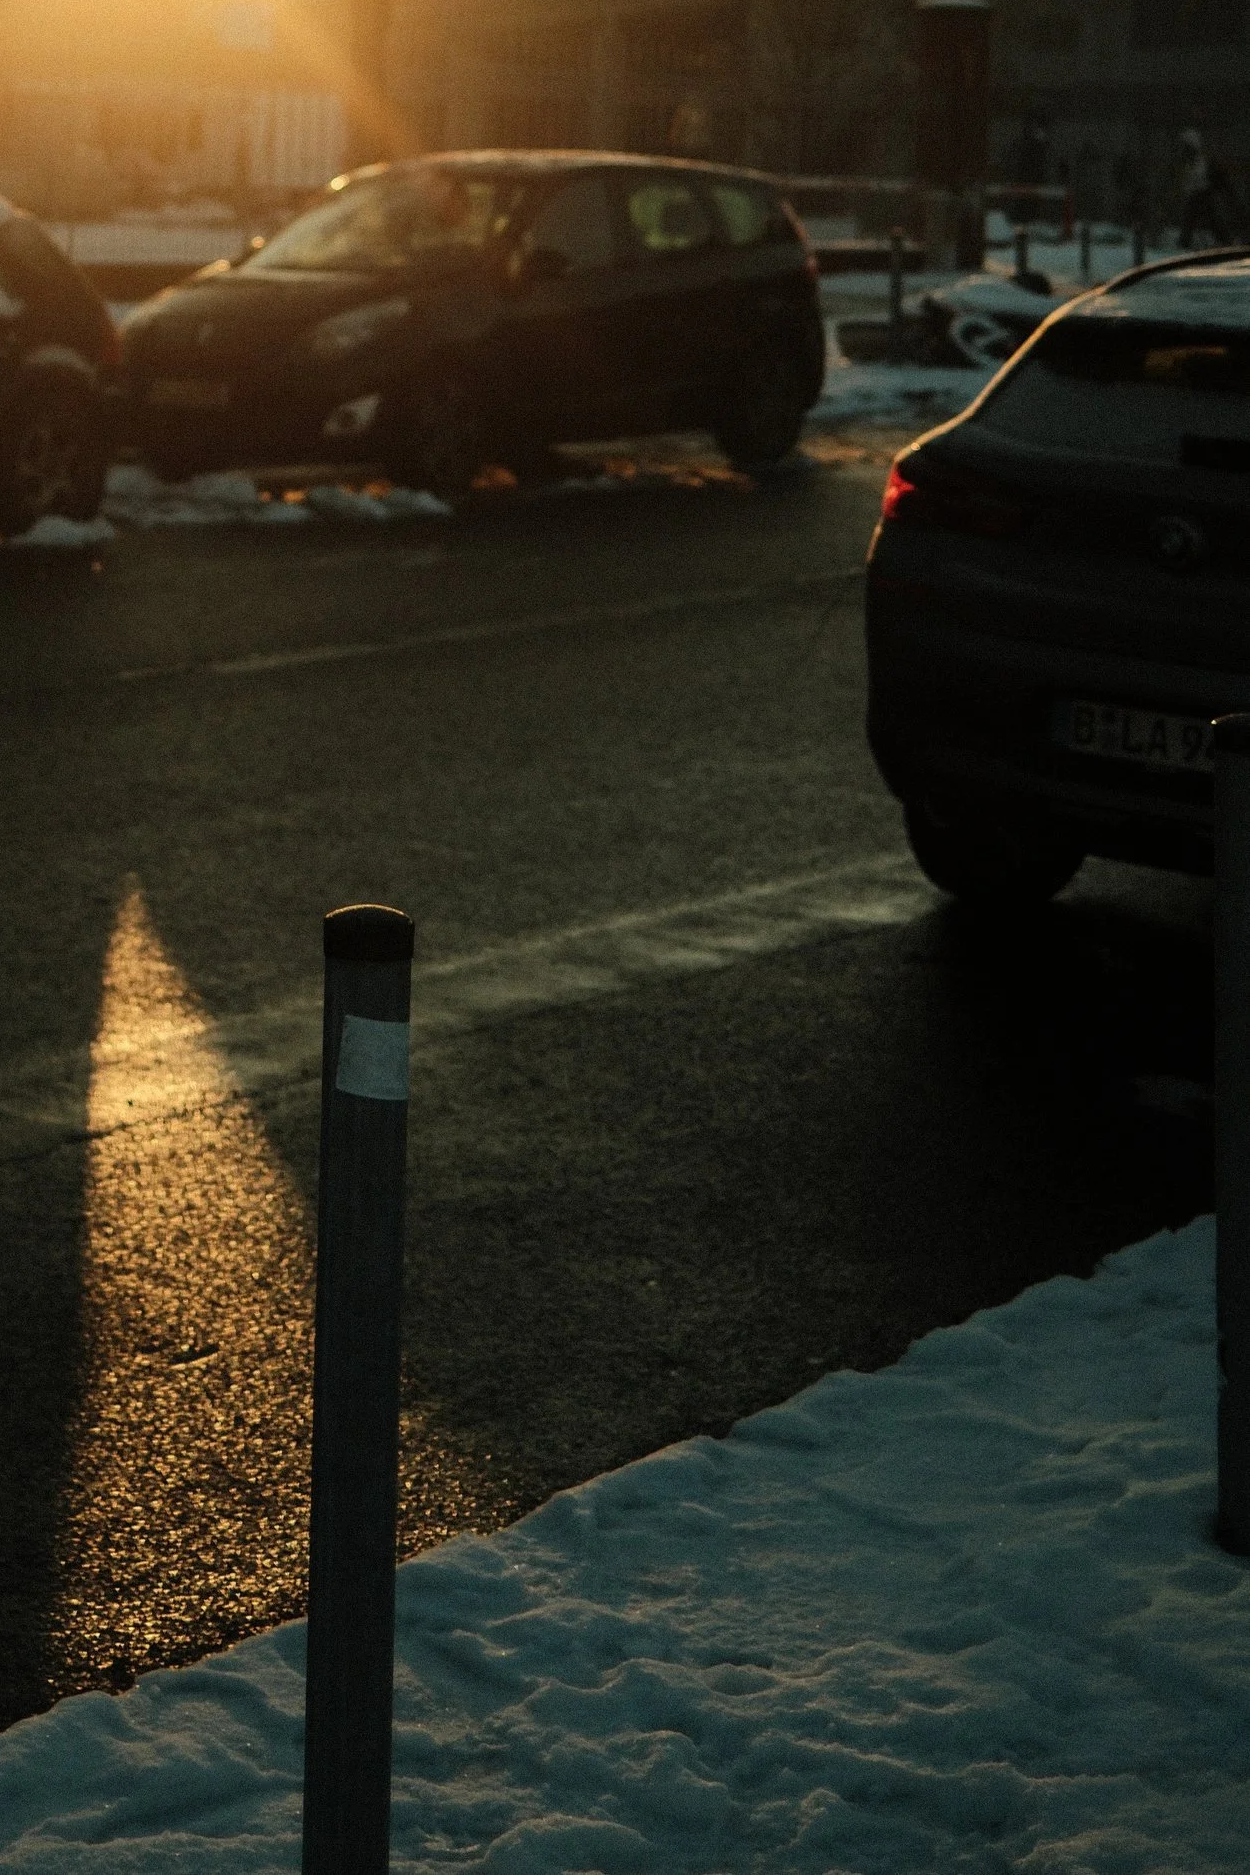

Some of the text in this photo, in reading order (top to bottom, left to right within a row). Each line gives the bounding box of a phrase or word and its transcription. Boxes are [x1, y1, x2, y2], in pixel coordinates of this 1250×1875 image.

[1074, 706, 1214, 761] B LA 9
